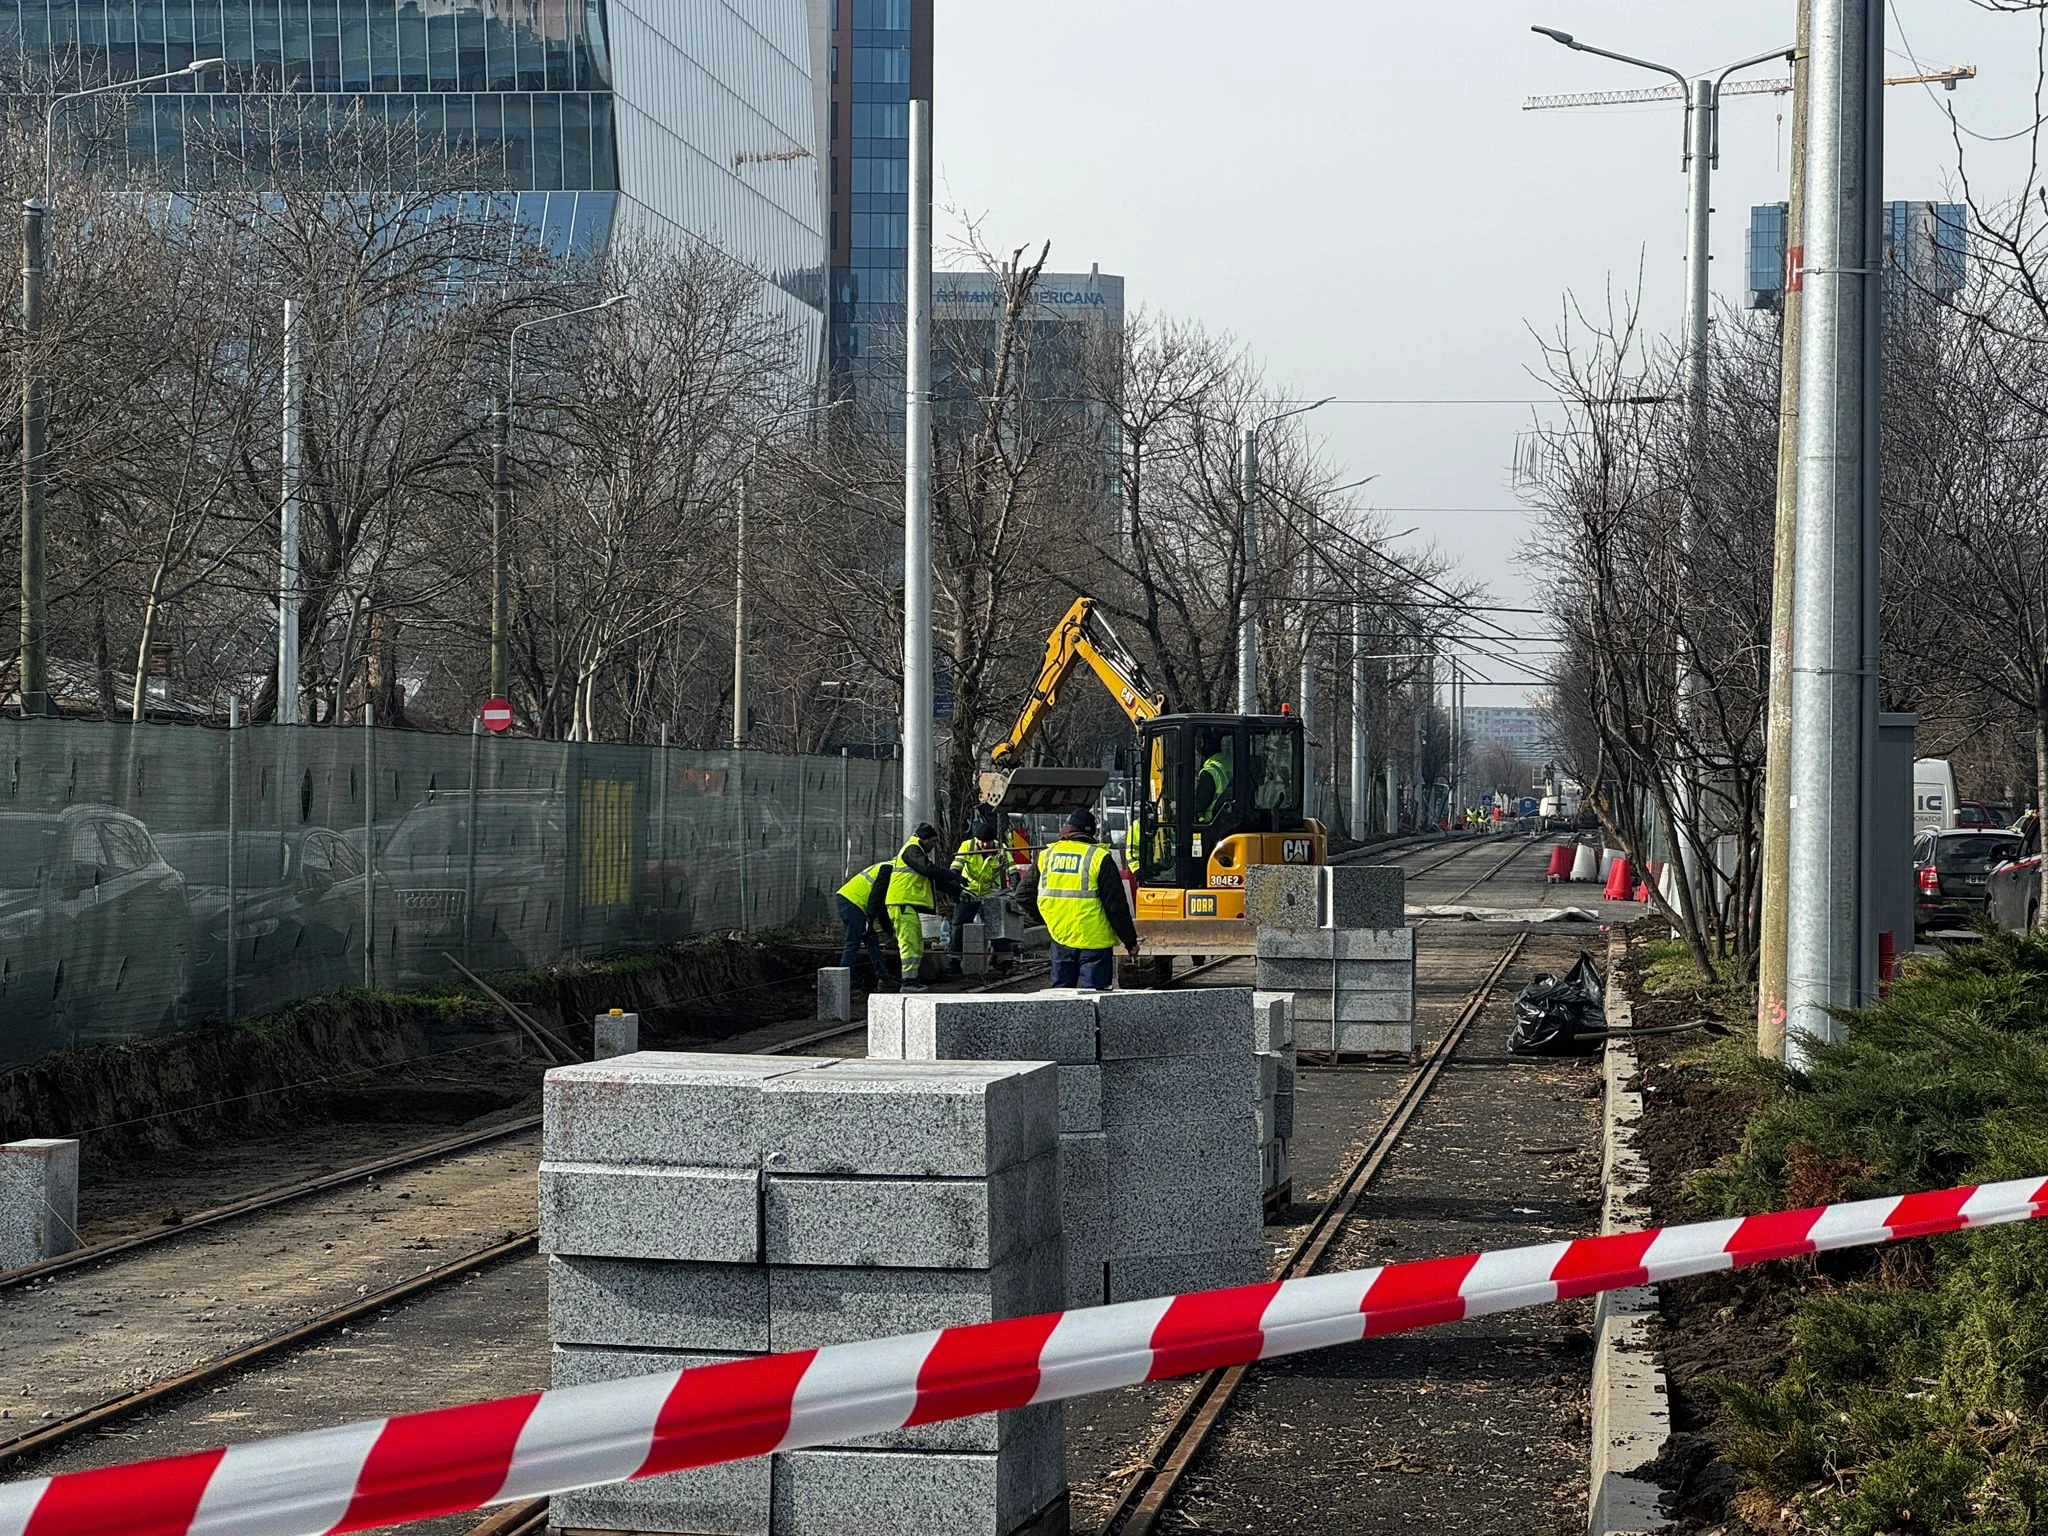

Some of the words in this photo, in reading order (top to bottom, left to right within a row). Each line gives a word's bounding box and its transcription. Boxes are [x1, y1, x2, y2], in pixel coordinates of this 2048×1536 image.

[1026, 291, 1105, 304] MERICANA
[1914, 815, 1942, 823] ORATOR
[1283, 839, 1311, 863] CAT
[1053, 855, 1078, 871] PORR
[1210, 875, 1240, 887] 304E2
[1190, 898, 1214, 914] PORR
